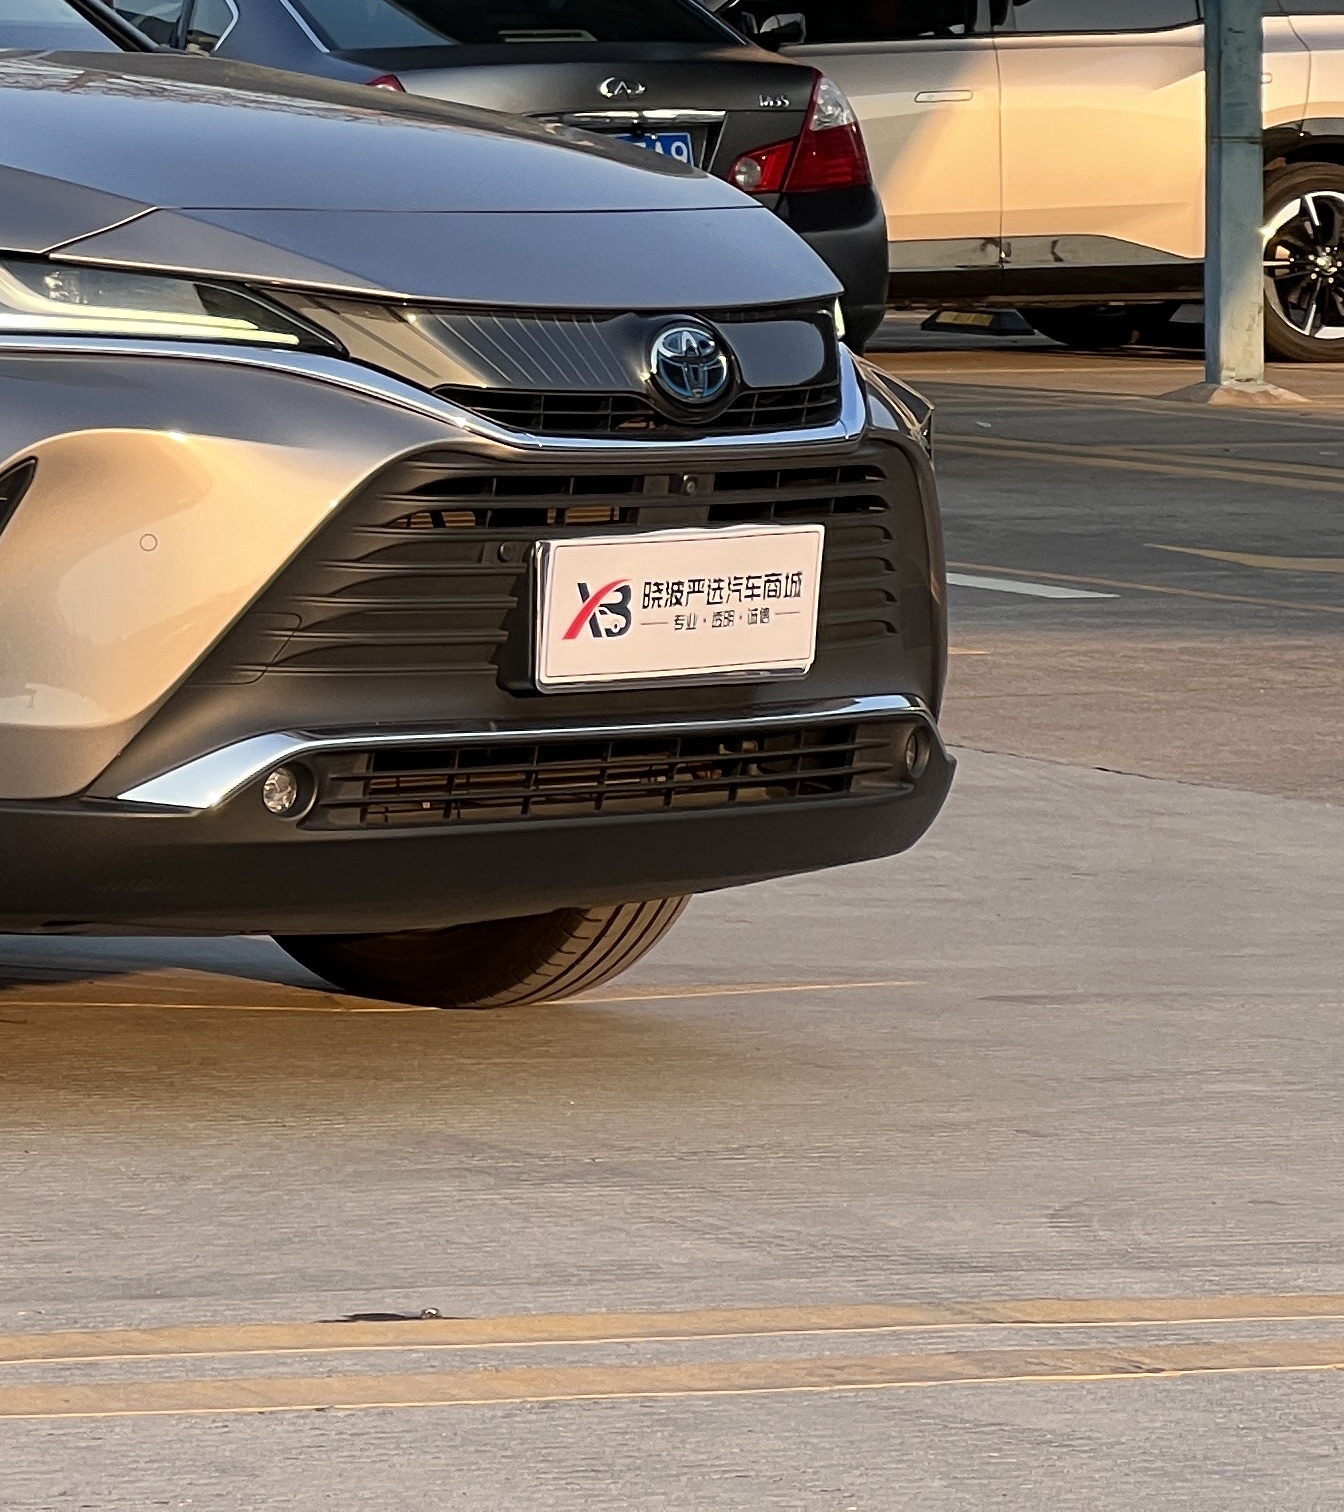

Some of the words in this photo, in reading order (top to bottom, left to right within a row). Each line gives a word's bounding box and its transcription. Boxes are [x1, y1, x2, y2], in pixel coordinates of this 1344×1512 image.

[642, 570, 804, 610] 晓波严选汽车商城
